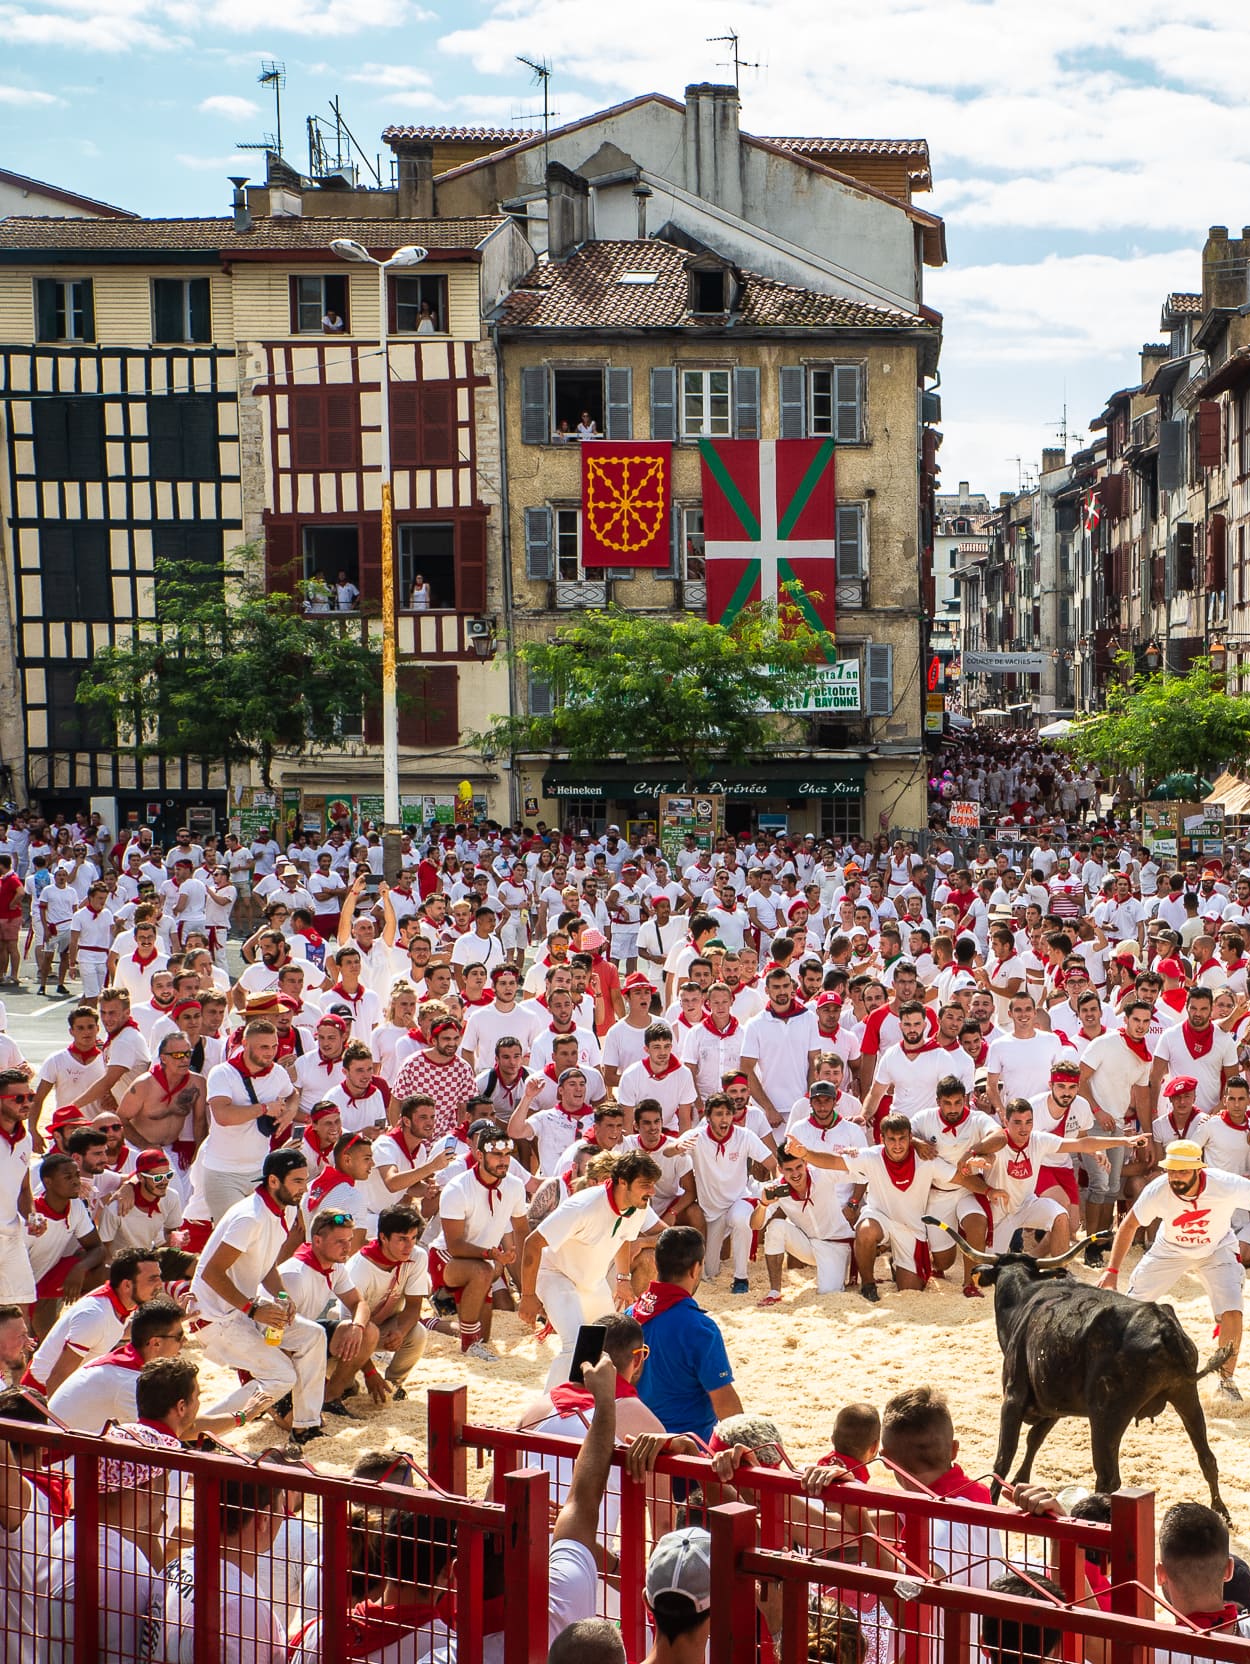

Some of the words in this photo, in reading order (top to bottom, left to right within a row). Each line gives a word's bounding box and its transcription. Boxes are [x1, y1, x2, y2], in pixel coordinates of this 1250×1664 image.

[814, 697, 859, 709] BAYONNE
[557, 785, 602, 795] Heineken
[633, 782, 669, 798] Café
[676, 783, 700, 795] ds
[799, 782, 828, 793] Chez
